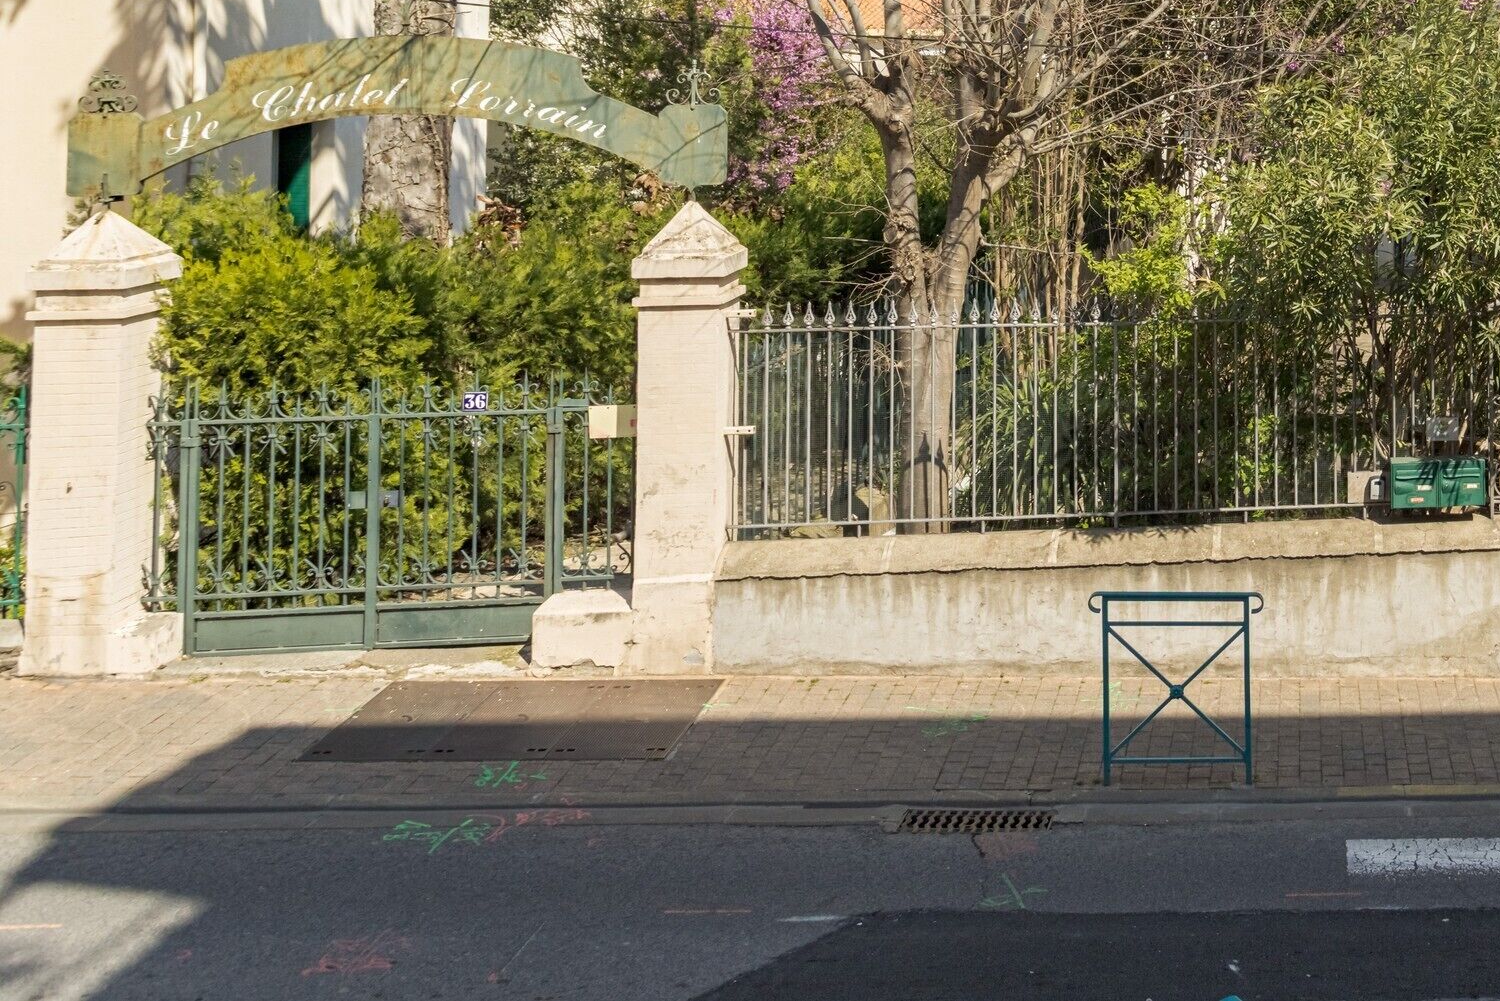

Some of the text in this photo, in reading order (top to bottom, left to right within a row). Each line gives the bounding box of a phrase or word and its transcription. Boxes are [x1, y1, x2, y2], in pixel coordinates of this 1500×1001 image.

[165, 73, 608, 156] Le Chalet Lorrain
[464, 393, 486, 409] 36
